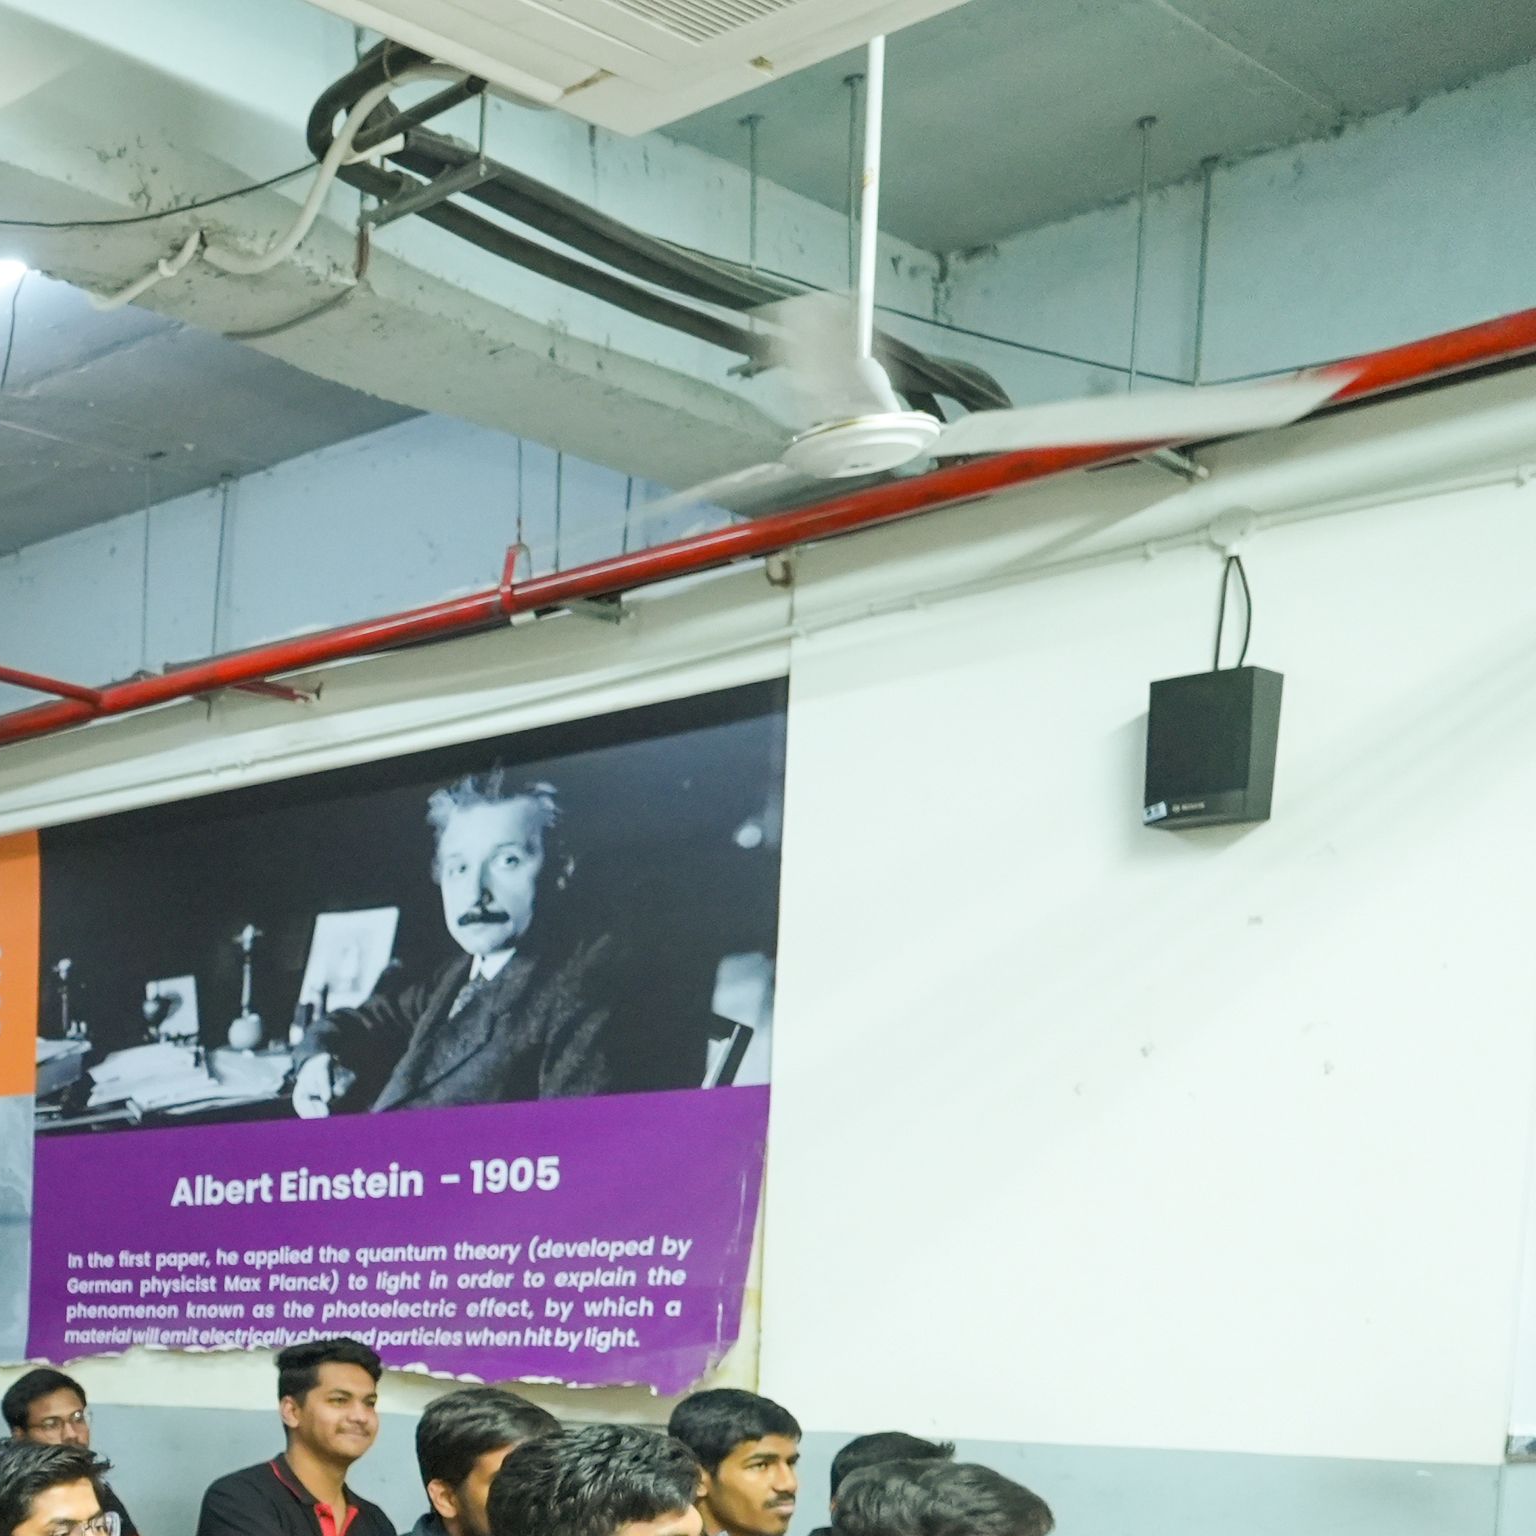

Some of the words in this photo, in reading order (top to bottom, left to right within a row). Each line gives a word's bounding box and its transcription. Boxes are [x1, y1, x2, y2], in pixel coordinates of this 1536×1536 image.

[170, 1172, 273, 1207] Albert
[280, 1162, 424, 1202] Einstein
[469, 1155, 561, 1194] 1905
[67, 1252, 84, 1269] In
[87, 1250, 115, 1268] the
[119, 1249, 151, 1268] first
[155, 1251, 212, 1272] paper,
[216, 1247, 240, 1265] he
[243, 1245, 314, 1270] applied
[319, 1244, 351, 1264] the
[355, 1243, 448, 1268] quantum
[453, 1241, 522, 1265] theory
[528, 1234, 655, 1263] (developed
[661, 1234, 693, 1262] by
[66, 1276, 134, 1295] German
[139, 1274, 218, 1298] physicist
[223, 1275, 262, 1293] Max
[268, 1268, 340, 1295] Planck)
[347, 1272, 369, 1291] to
[376, 1270, 421, 1296] light
[428, 1269, 449, 1290] in
[457, 1268, 515, 1290] order
[523, 1269, 546, 1288] to
[554, 1264, 638, 1293] explain
[647, 1264, 688, 1287] the
[66, 1301, 180, 1324] phenomenon
[185, 1301, 246, 1319] known
[252, 1303, 276, 1319] as
[283, 1300, 316, 1319] the
[321, 1298, 458, 1324] photoelectric
[465, 1297, 535, 1321] effect,
[544, 1297, 575, 1323] by
[583, 1295, 655, 1318] which
[664, 1299, 682, 1318] a
[64, 1326, 132, 1345] material
[132, 1326, 161, 1345] will
[160, 1325, 200, 1345] emit
[376, 1326, 463, 1351] particles
[465, 1326, 522, 1347] when
[523, 1326, 553, 1347] hit
[554, 1326, 584, 1353] by
[584, 1325, 641, 1353] light.
